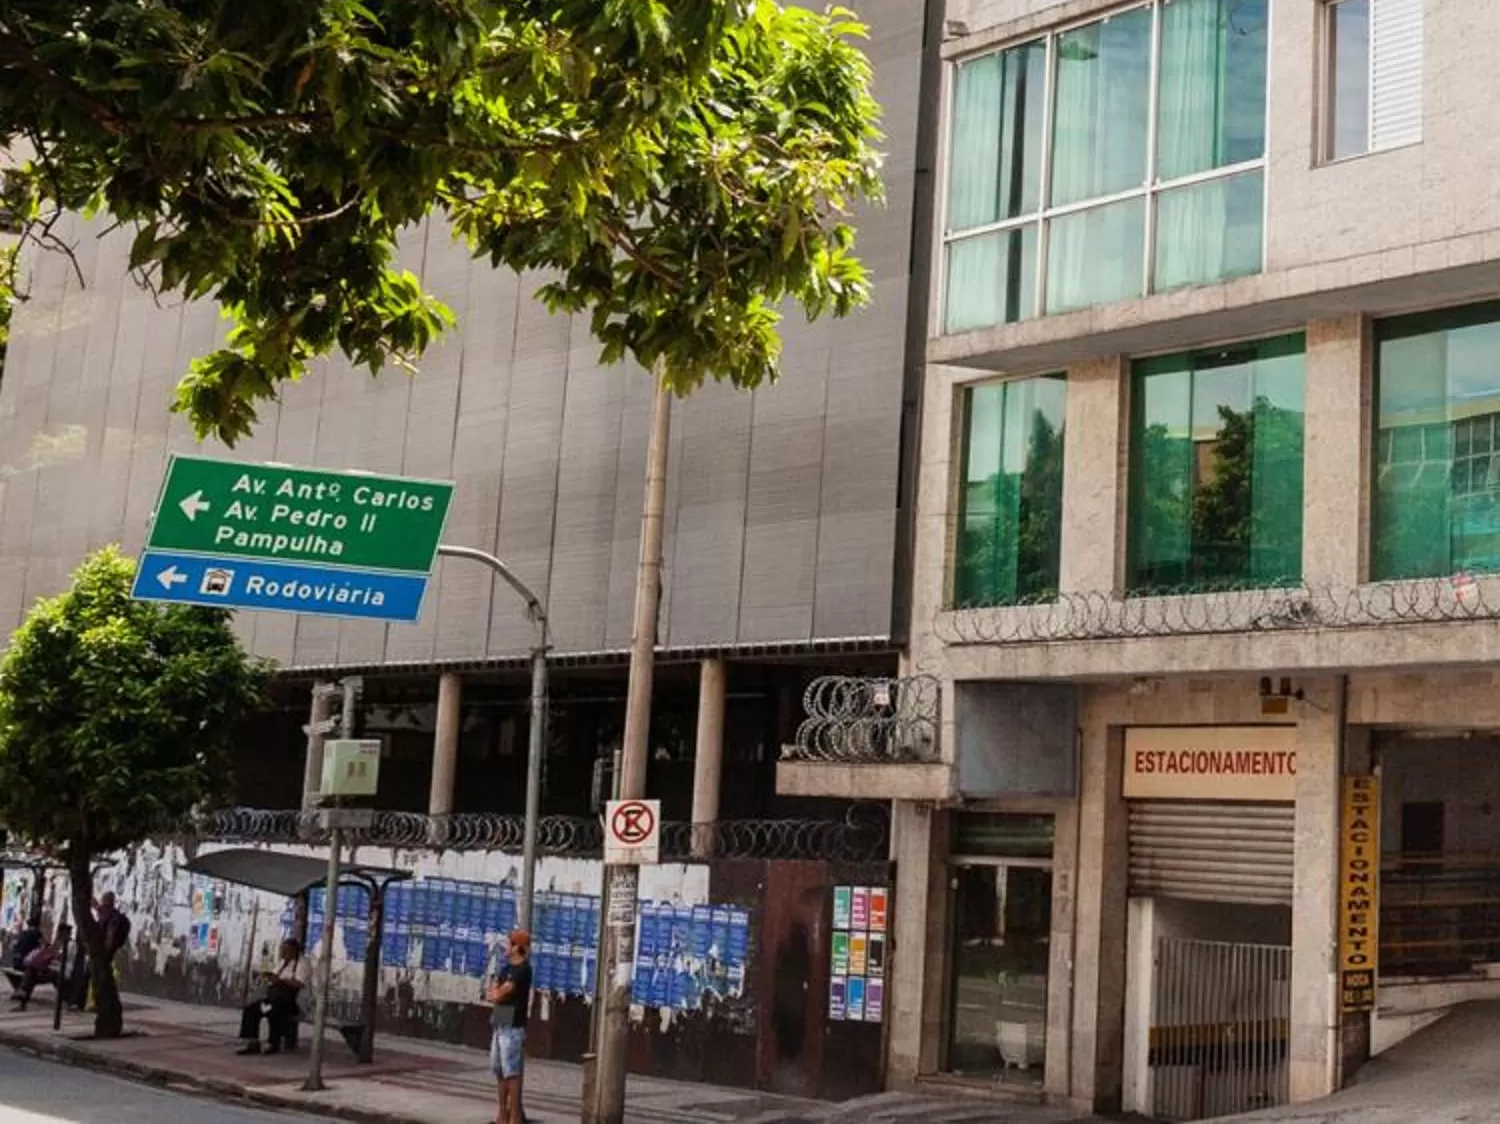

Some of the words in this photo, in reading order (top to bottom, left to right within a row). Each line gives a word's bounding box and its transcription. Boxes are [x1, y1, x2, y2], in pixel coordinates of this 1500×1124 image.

[232, 474, 266, 496] Av.
[353, 487, 434, 511] Carlos
[224, 500, 257, 522] Av.
[271, 504, 347, 529] Pedro
[214, 526, 344, 556] Pampulha
[1347, 779, 1371, 965] ESTACIONAMENTO
